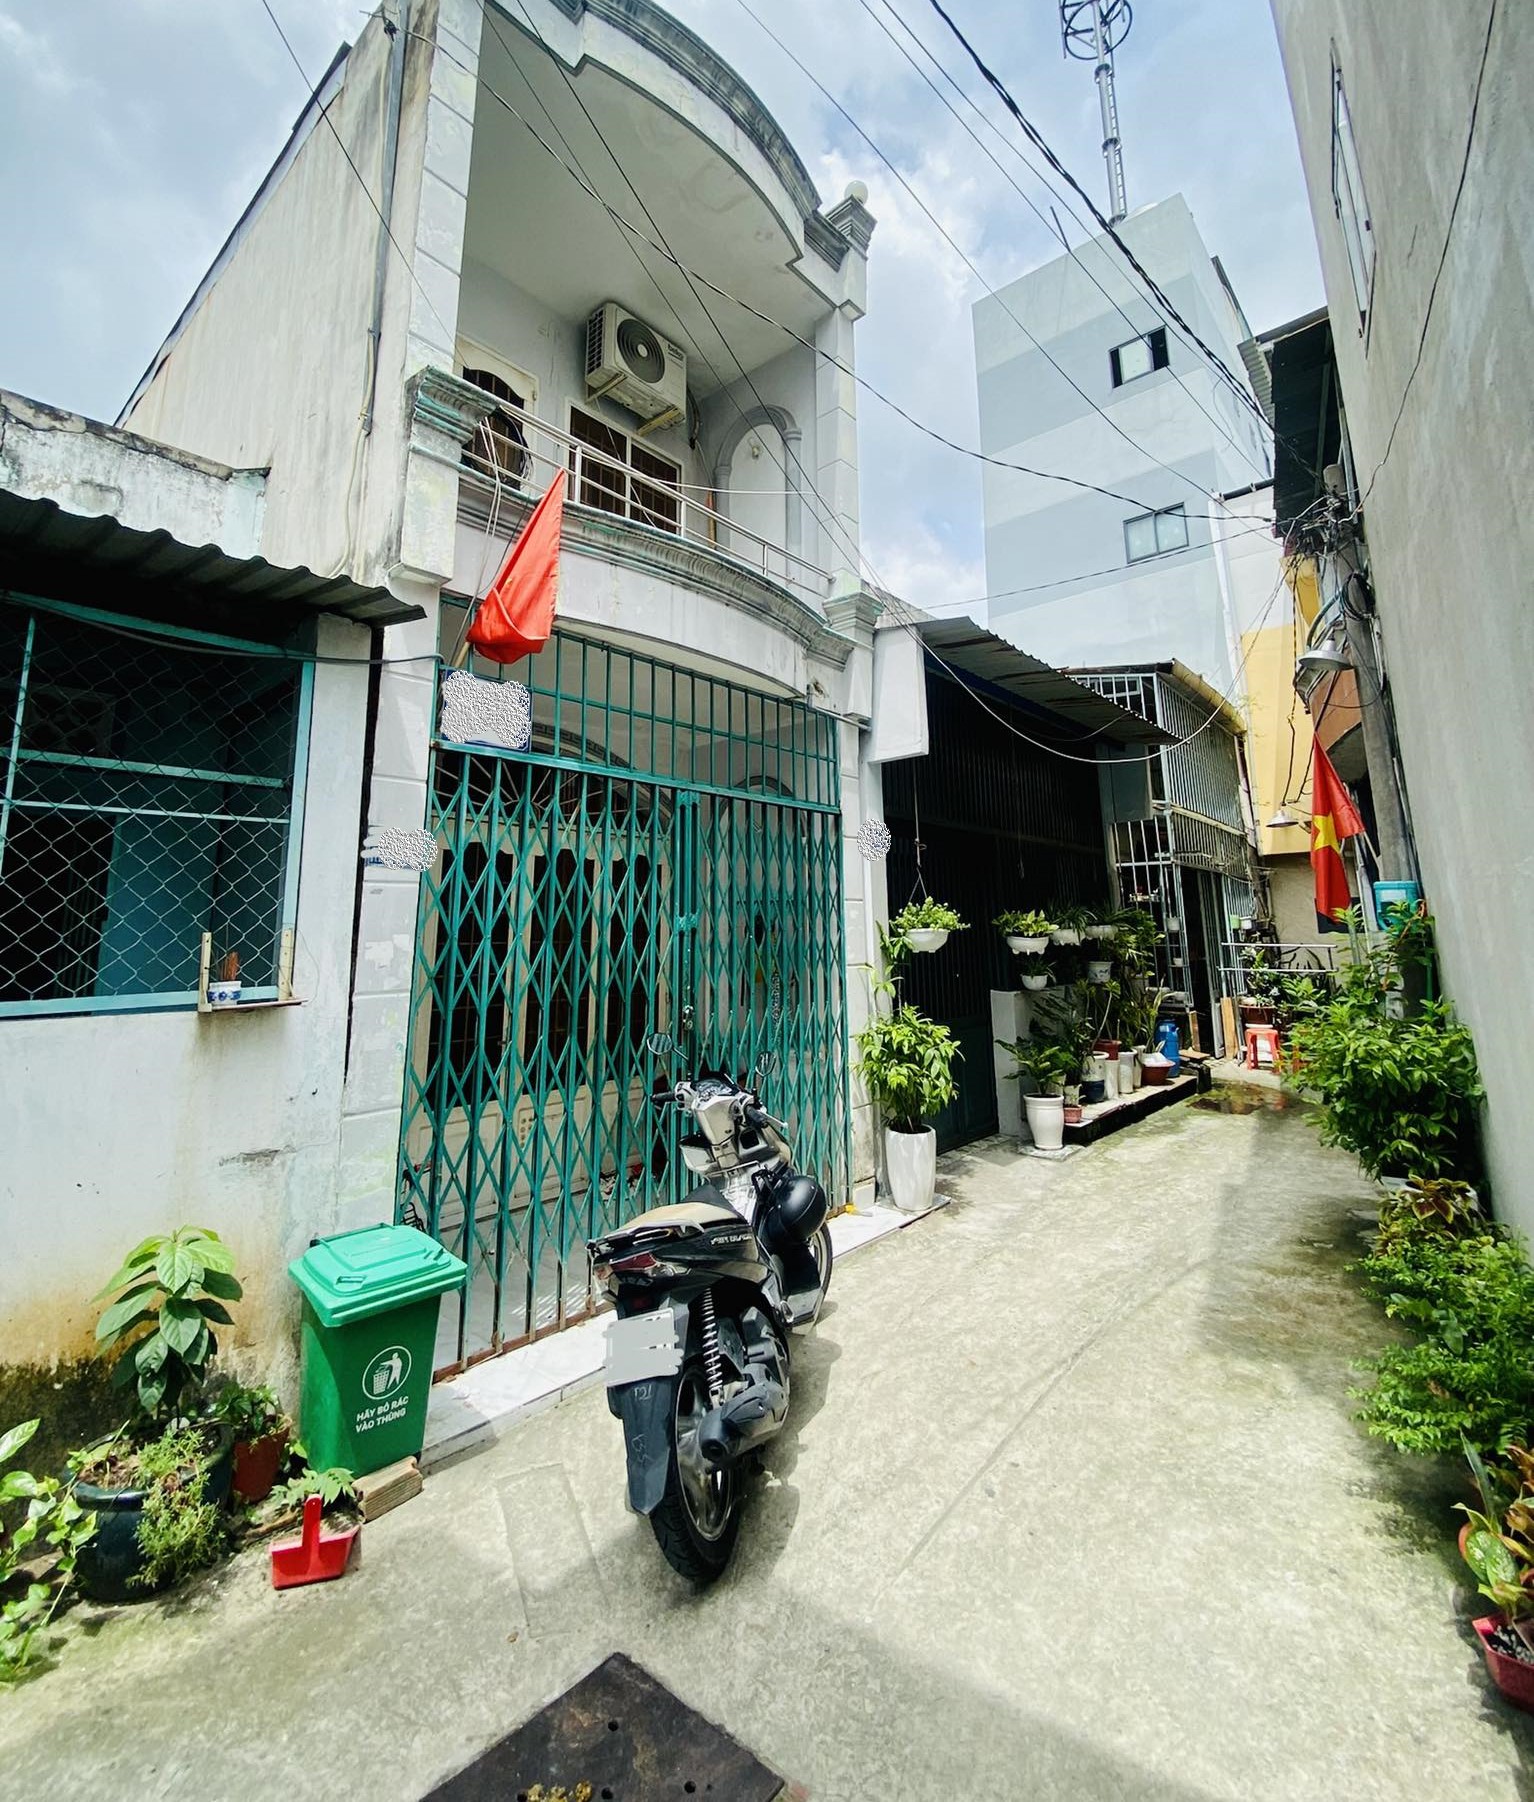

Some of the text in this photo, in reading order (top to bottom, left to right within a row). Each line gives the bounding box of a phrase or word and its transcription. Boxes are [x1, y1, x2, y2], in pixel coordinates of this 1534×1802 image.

[355, 1407, 406, 1433] VÀO THÙNG
[356, 1408, 376, 1422] HÃY
[391, 1396, 409, 1410] RÁC
